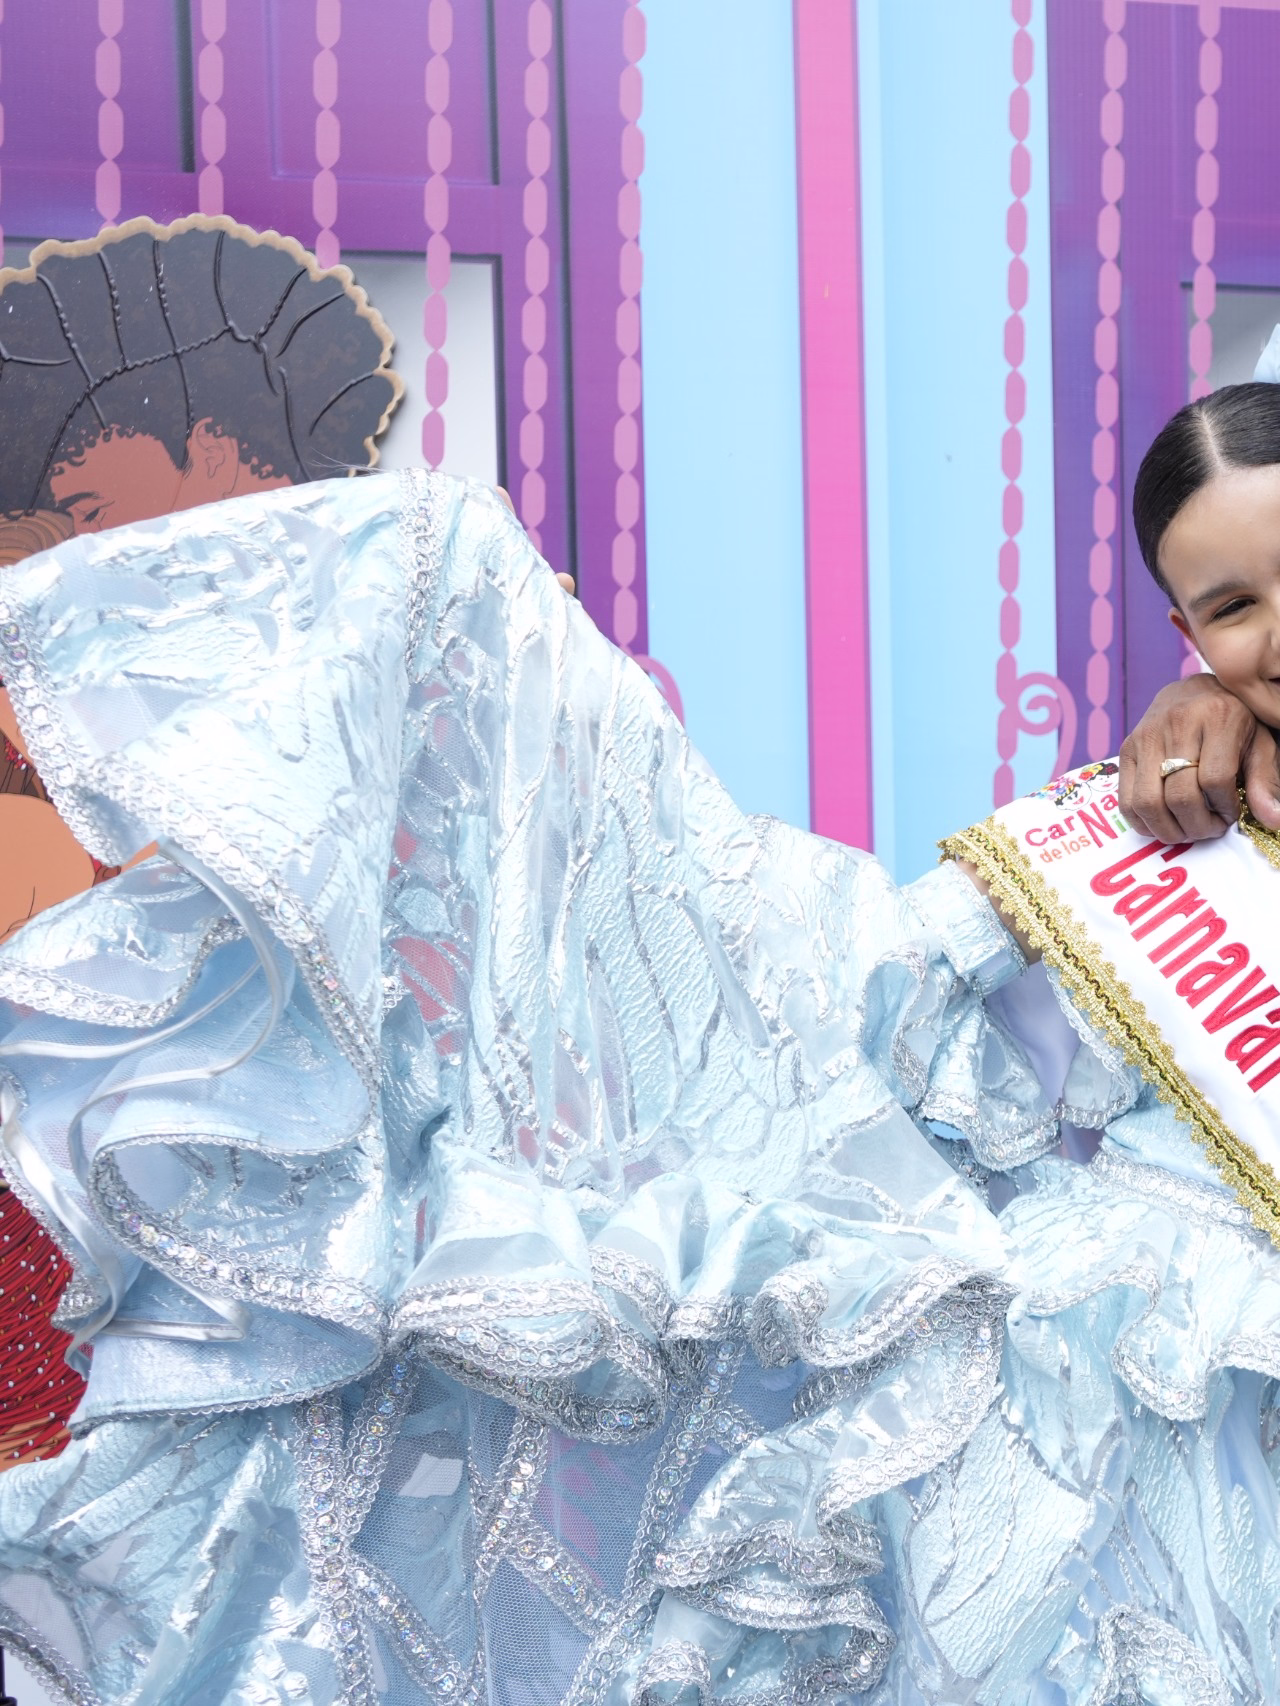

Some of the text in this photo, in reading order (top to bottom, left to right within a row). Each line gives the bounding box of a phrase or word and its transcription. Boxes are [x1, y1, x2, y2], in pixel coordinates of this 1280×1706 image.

[1025, 789, 1119, 848] CarNa
[1039, 835, 1091, 863] de los
